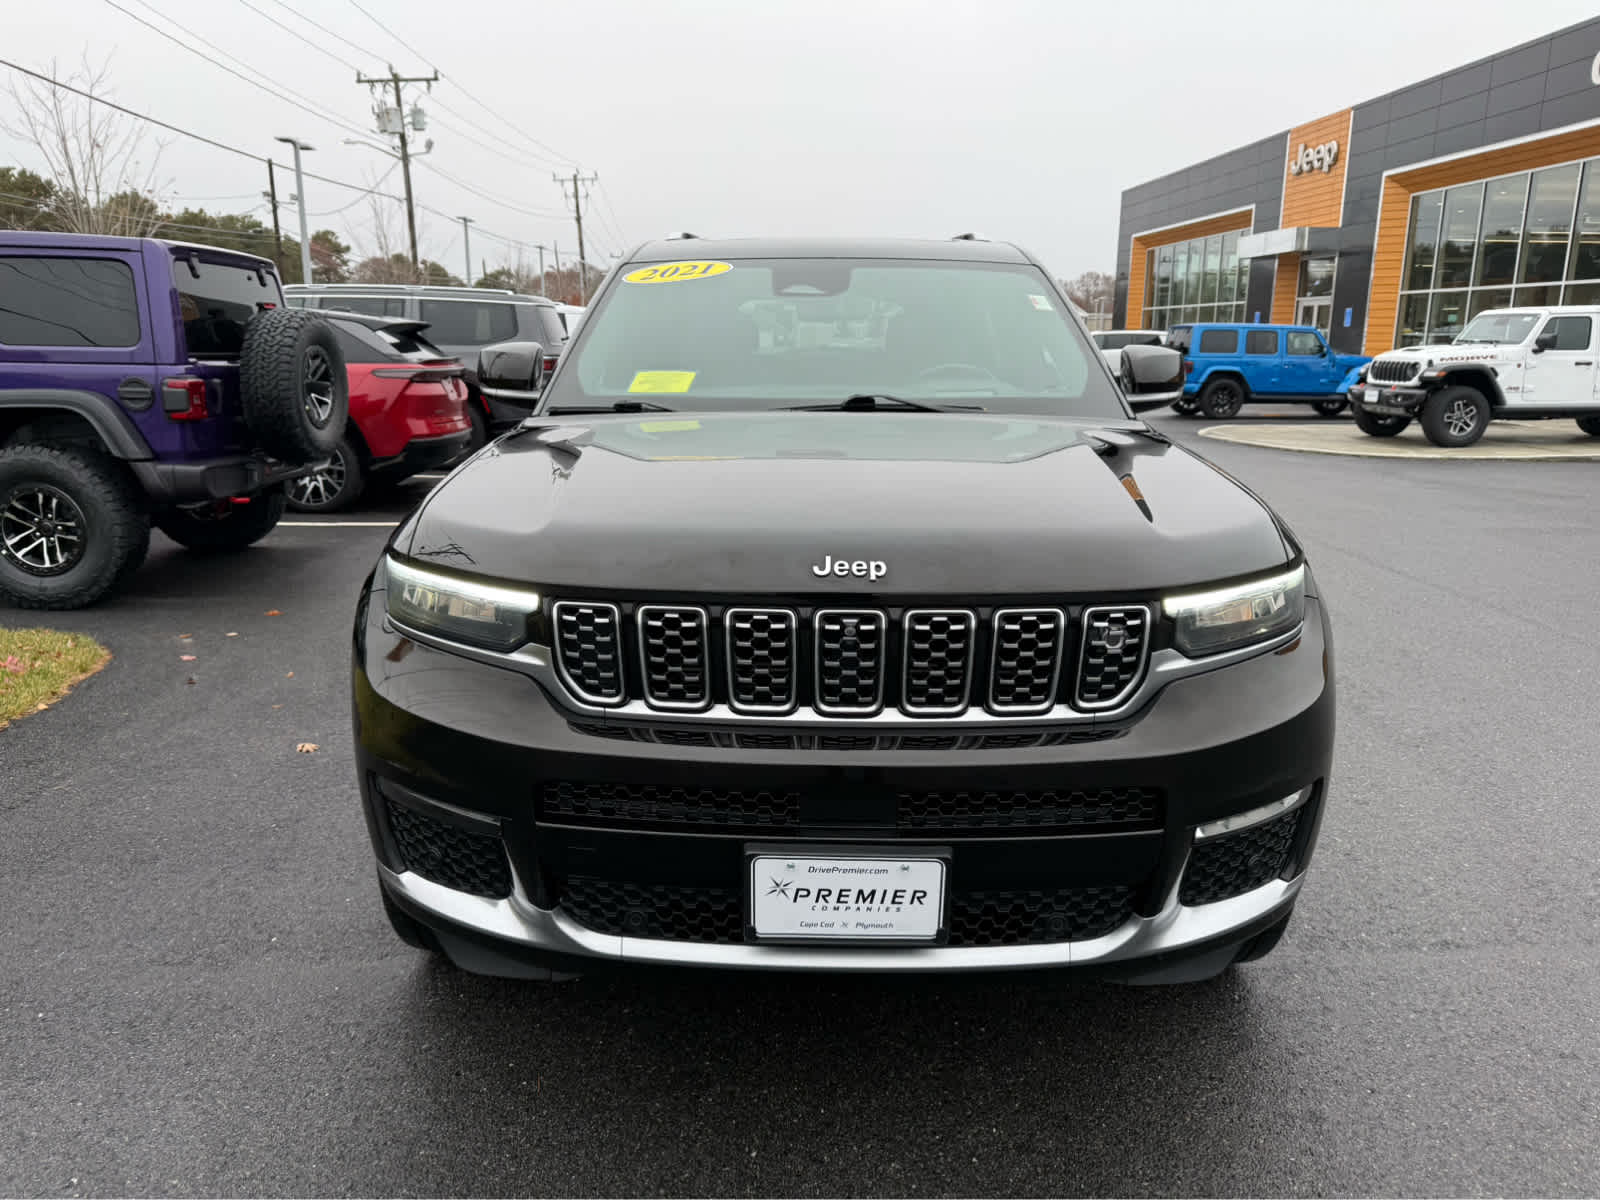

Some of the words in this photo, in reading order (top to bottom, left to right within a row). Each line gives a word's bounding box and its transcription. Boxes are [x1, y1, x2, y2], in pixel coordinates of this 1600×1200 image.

[1291, 141, 1339, 176] Jeep
[639, 263, 715, 281] 2021
[1440, 354, 1497, 362] MOJAVE
[812, 555, 887, 581] Jeep
[808, 865, 889, 875] DrivePremier.com
[792, 888, 928, 905] PREMIER
[799, 921, 819, 930] Cape
[820, 921, 835, 929] Cod
[855, 921, 894, 930] Plymouth
